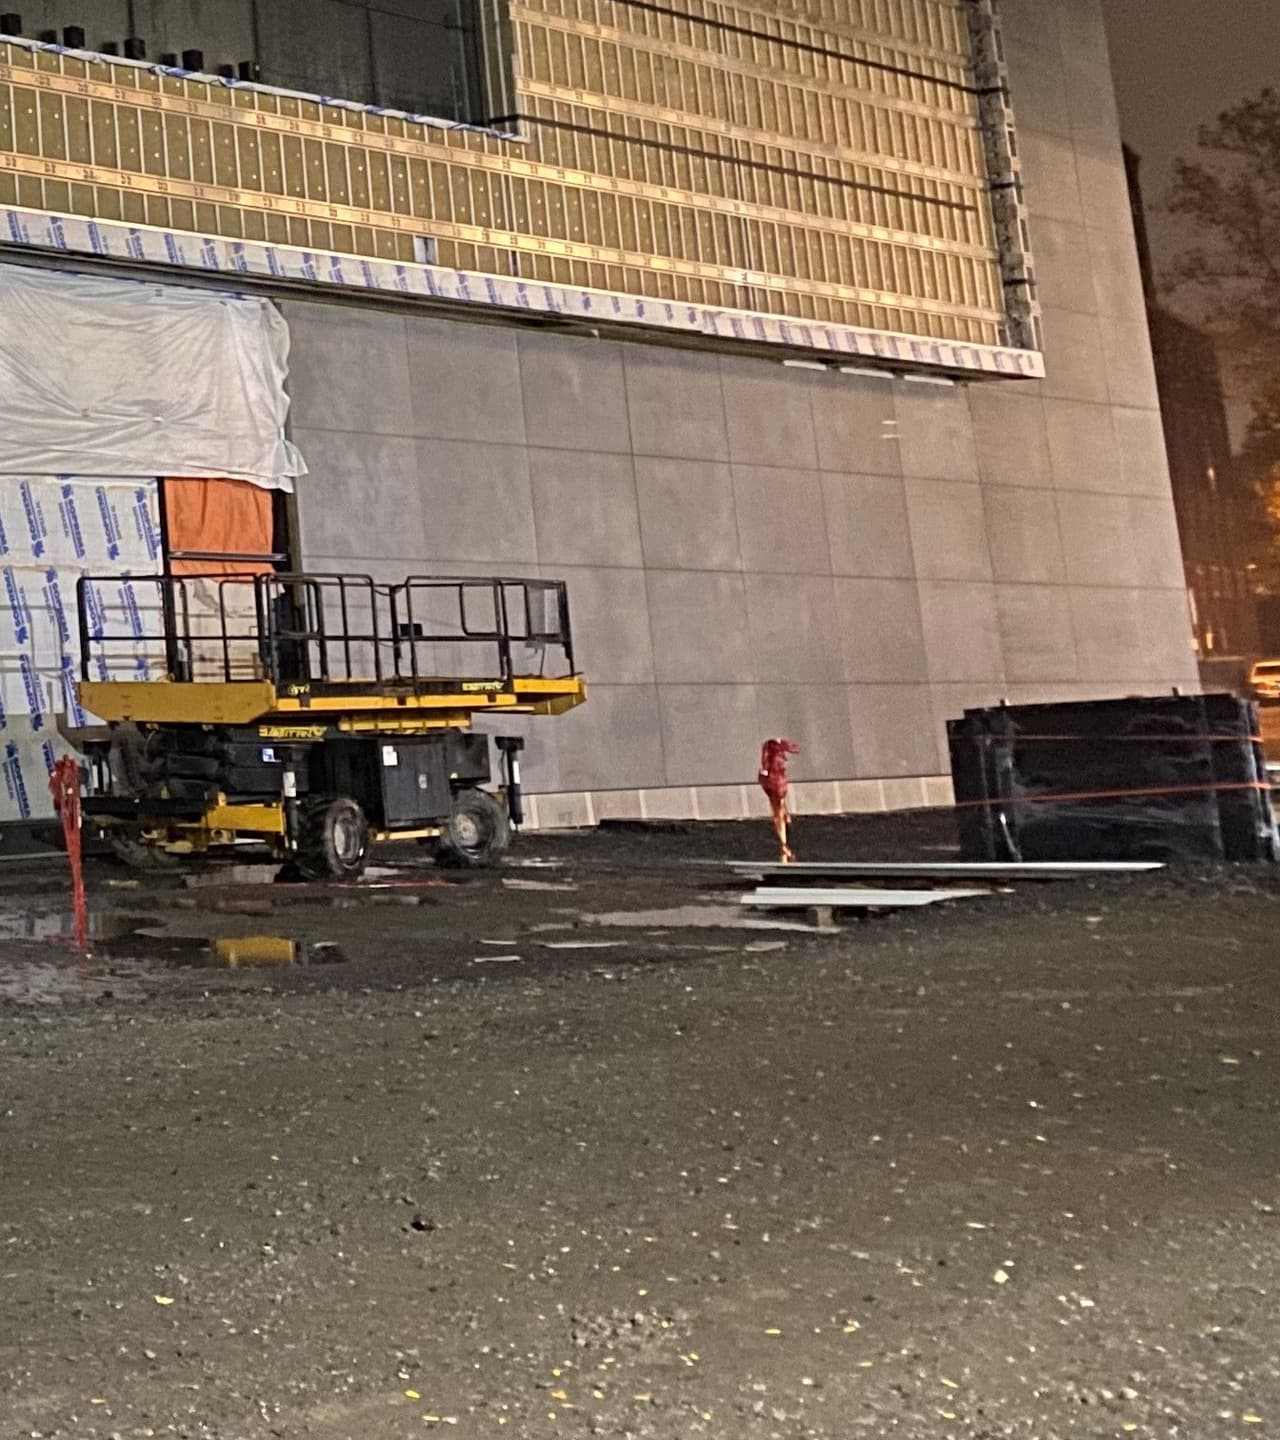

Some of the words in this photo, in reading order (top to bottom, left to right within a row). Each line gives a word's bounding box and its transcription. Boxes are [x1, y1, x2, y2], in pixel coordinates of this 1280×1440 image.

[20, 481, 38, 541] SOPREMA
[68, 498, 85, 558] SOPREMA
[96, 487, 113, 543] SOPREMA
[3, 568, 21, 622] SOPREMA
[52, 583, 70, 642] SOPREMA
[20, 655, 38, 714] SOPREMA
[13, 758, 31, 818] SOPREMA
